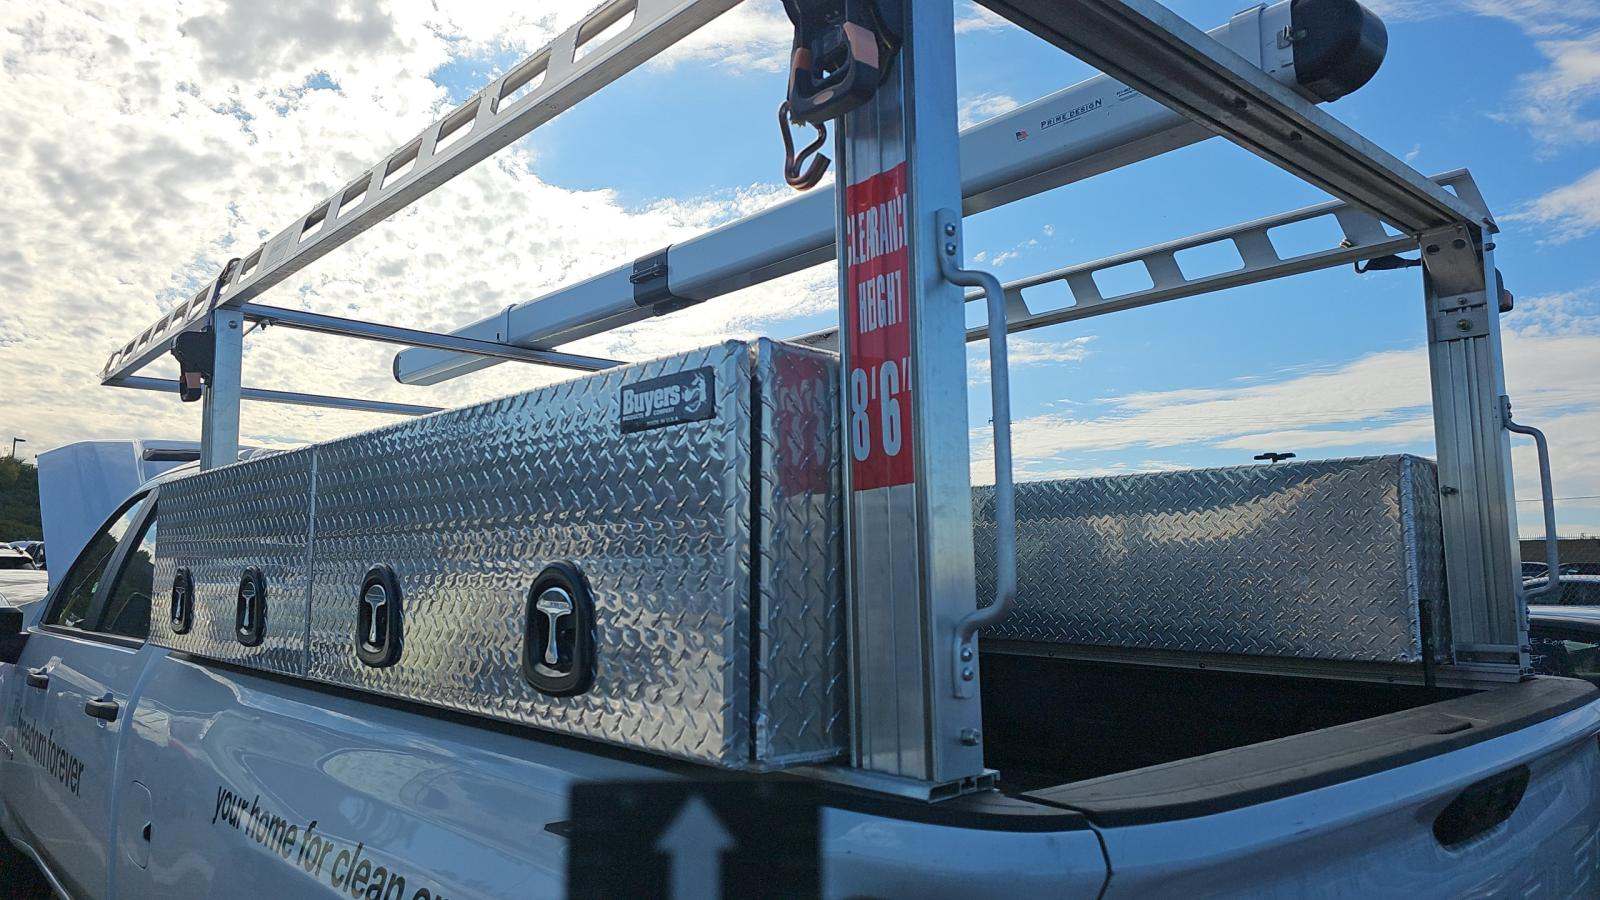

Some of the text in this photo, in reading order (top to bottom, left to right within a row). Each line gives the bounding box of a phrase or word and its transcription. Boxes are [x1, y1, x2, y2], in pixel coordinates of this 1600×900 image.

[1041, 98, 1103, 128] PRIME DESIGN
[622, 385, 681, 417] Buyers
[46, 729, 84, 797] forever
[212, 786, 406, 900] your home for clean
